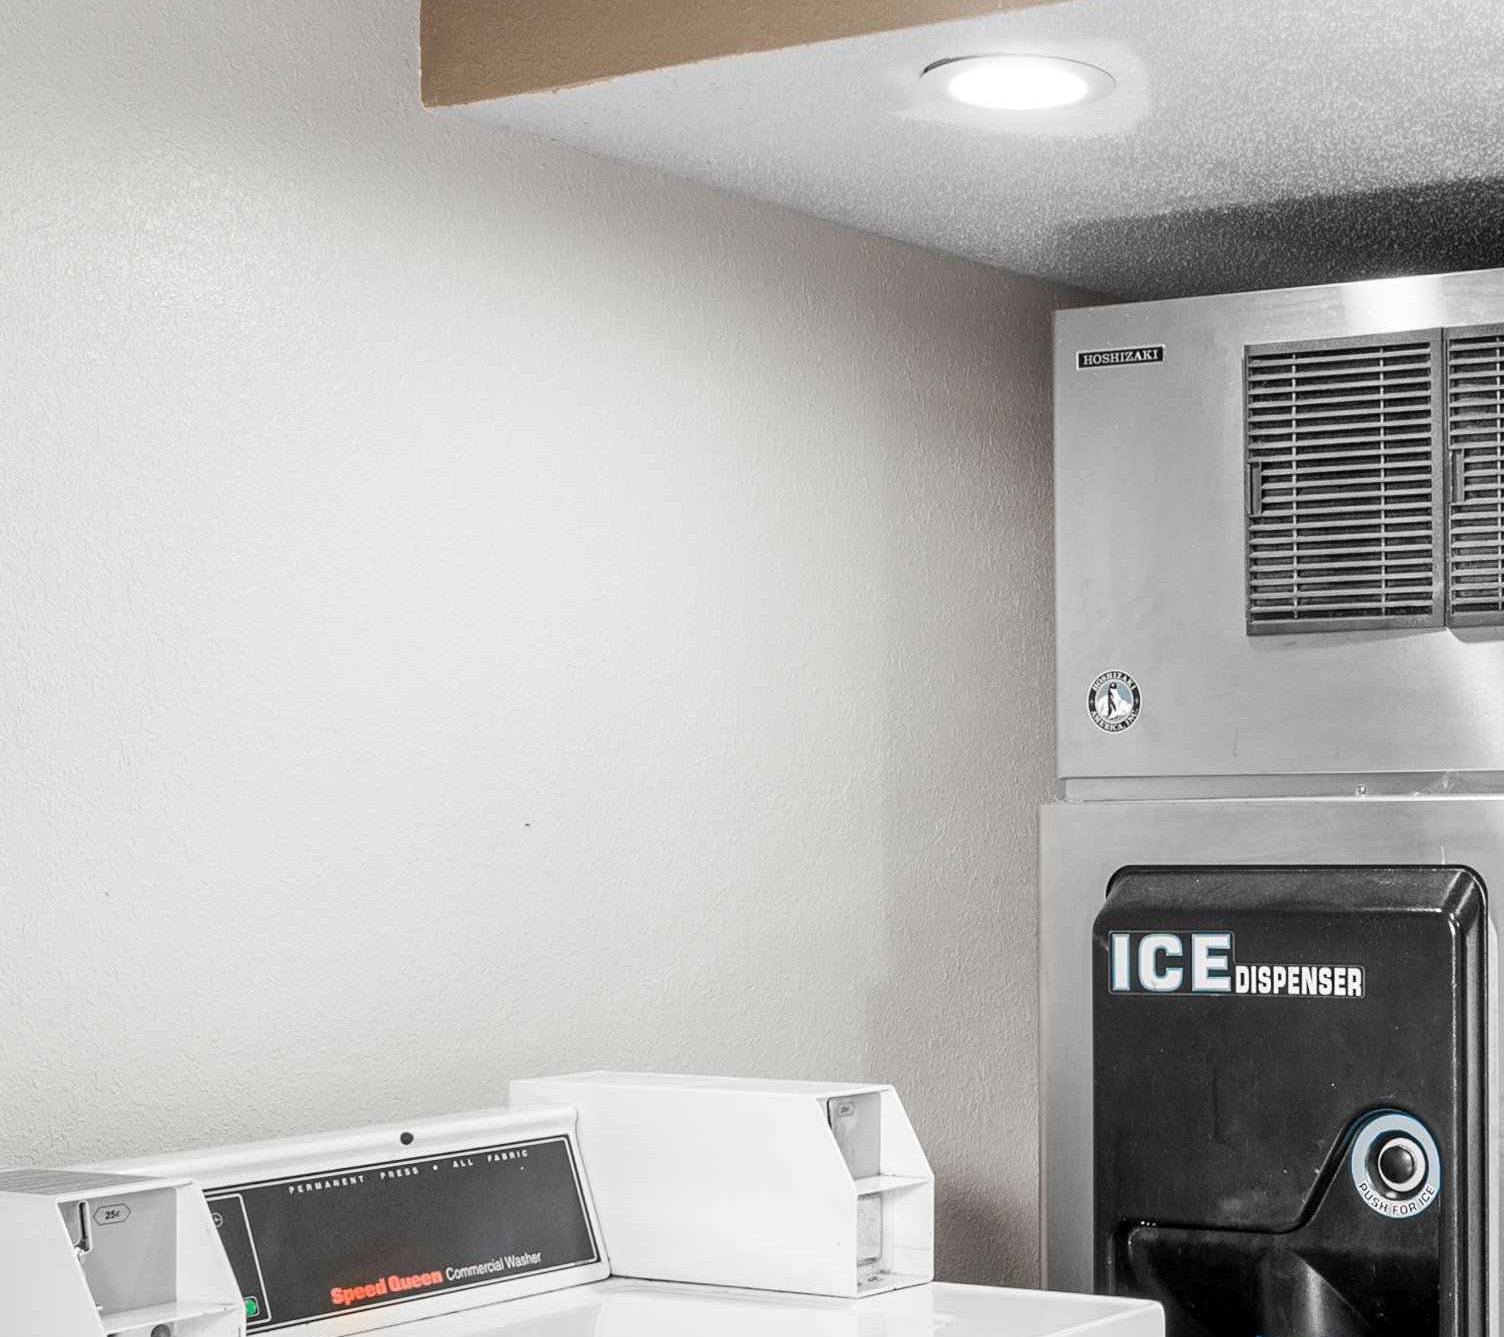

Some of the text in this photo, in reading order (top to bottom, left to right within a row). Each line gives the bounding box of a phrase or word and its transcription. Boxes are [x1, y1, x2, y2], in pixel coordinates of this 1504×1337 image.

[1083, 349, 1158, 365] HOSHIZAKI
[1112, 933, 1362, 996] ICE DISPENSER
[289, 1149, 529, 1194] PERMANENT PRESS ALL FABRIC
[1359, 1182, 1435, 1215] PUSH FOR ICE
[330, 1250, 542, 1305] Speed Queen Commercial Washer
